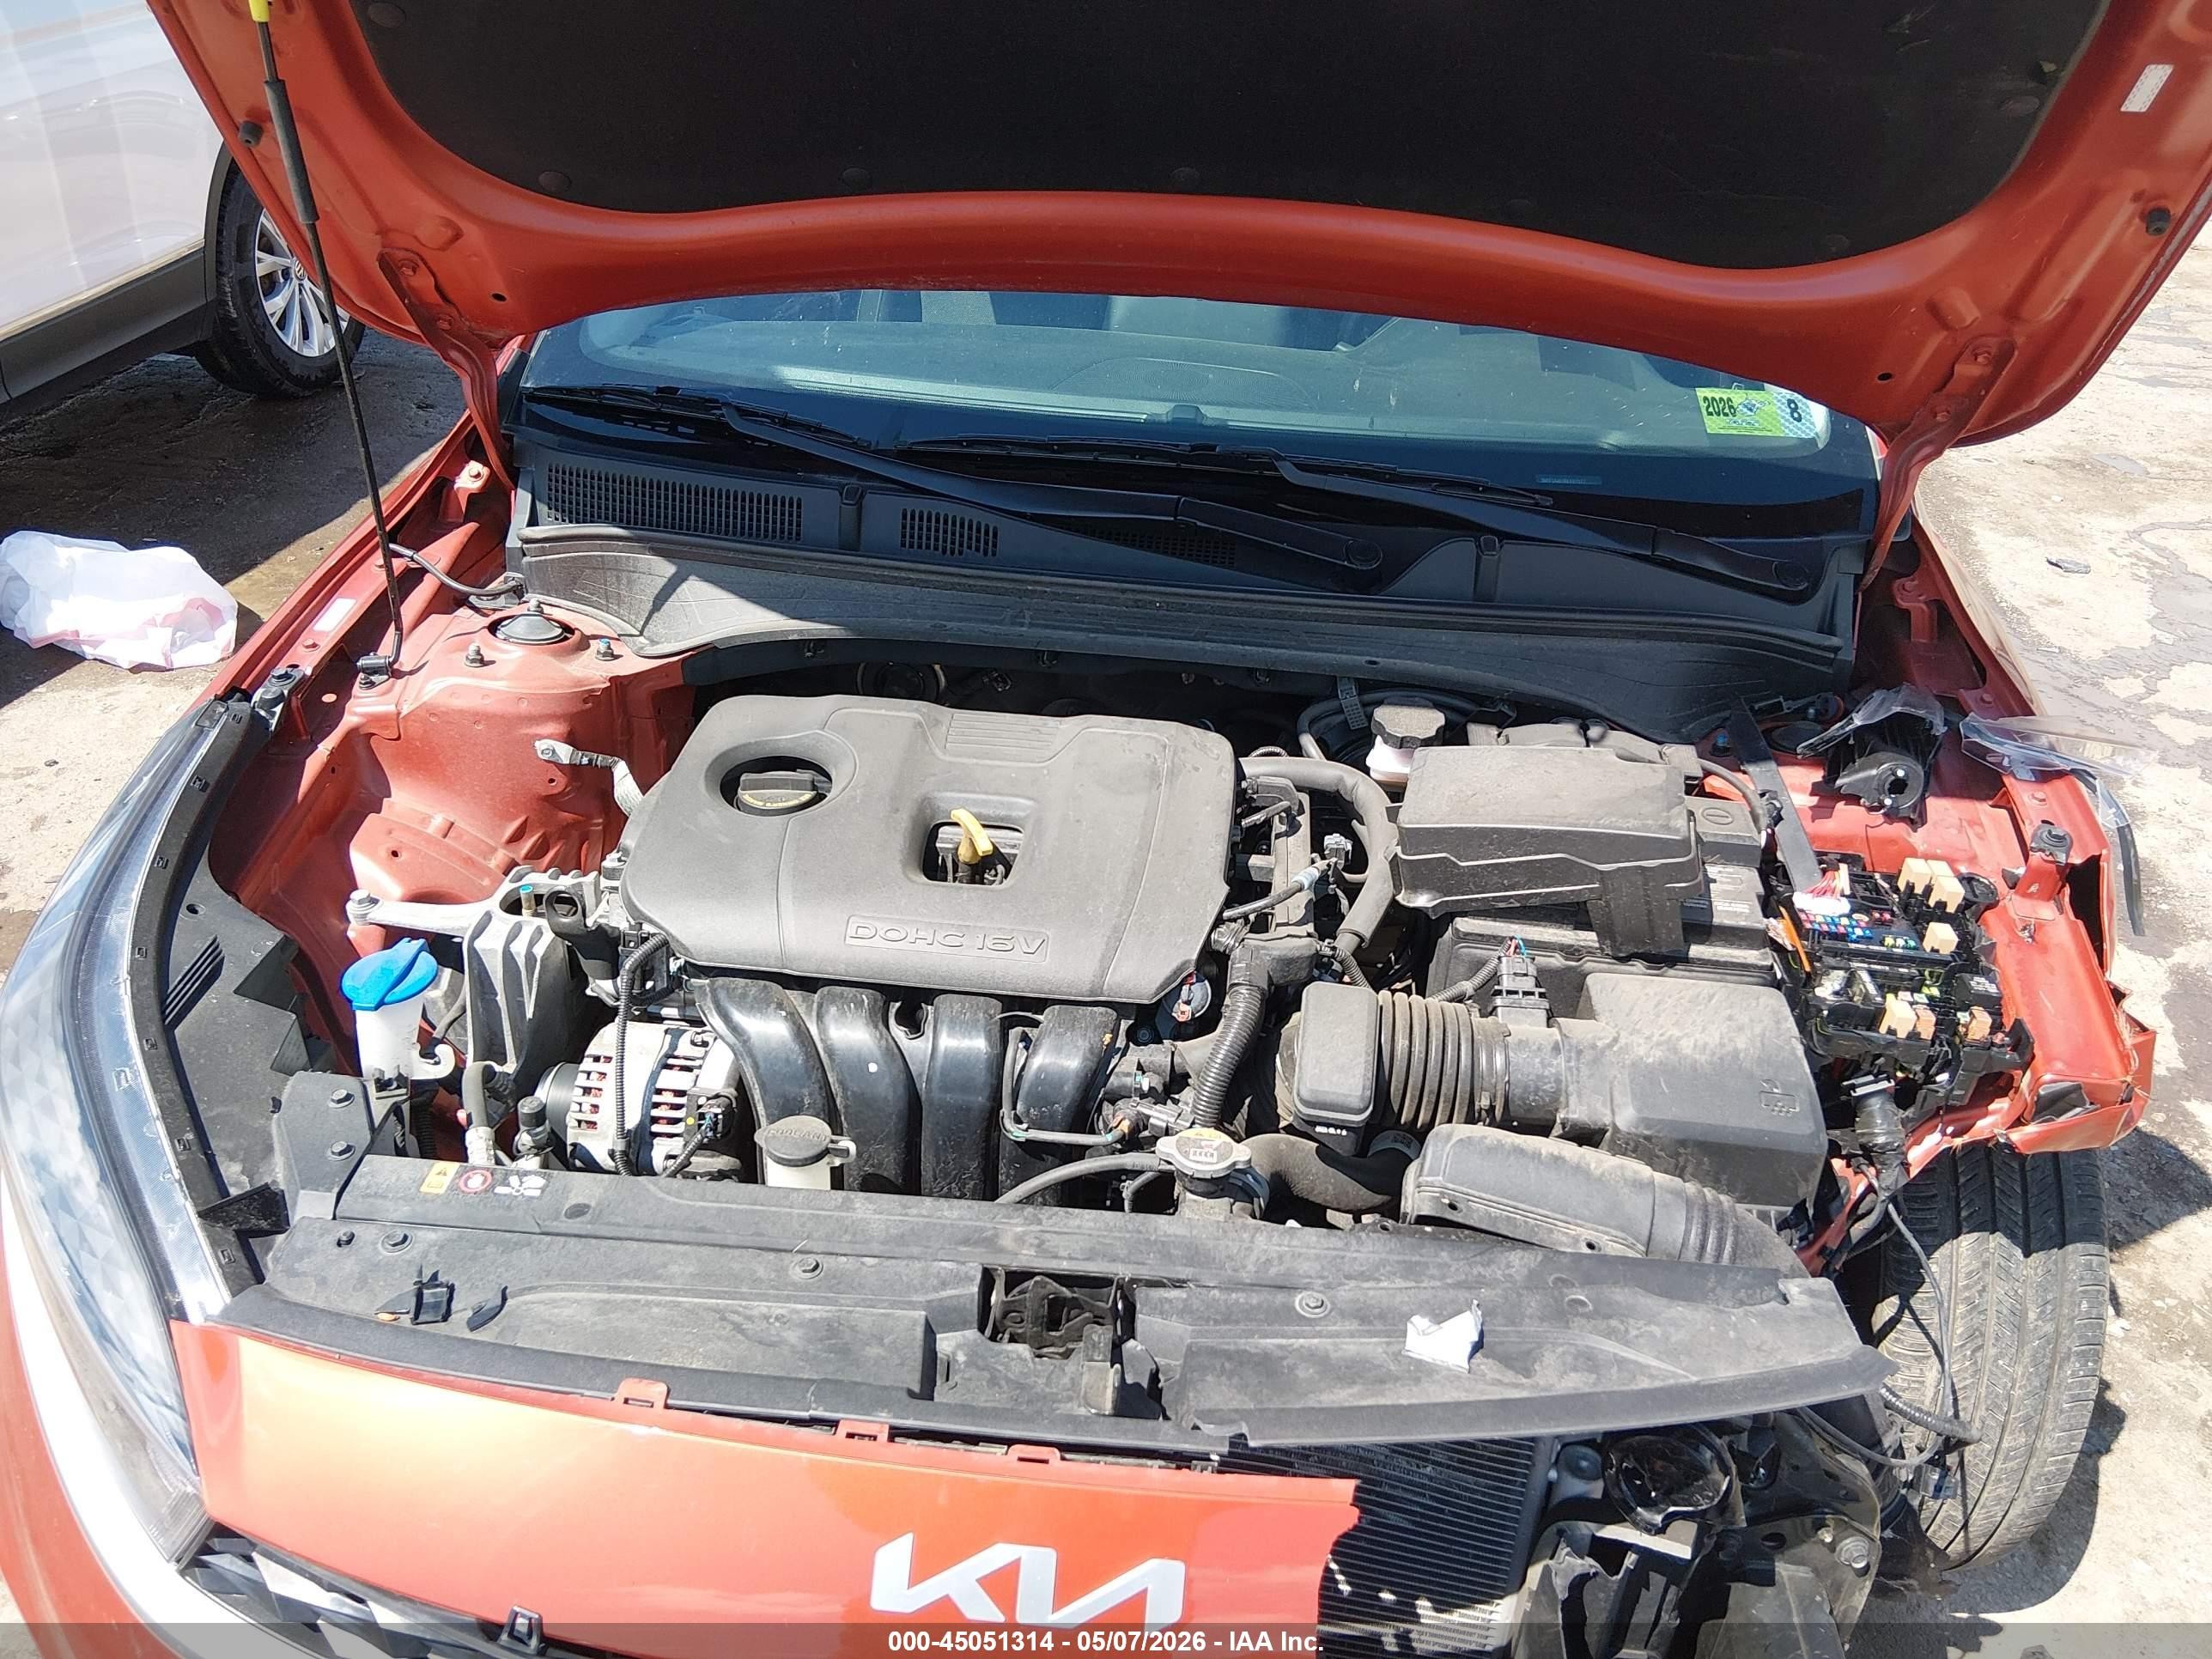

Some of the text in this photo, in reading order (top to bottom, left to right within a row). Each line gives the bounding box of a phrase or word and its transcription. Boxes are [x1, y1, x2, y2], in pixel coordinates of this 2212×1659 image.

[1703, 396, 1737, 417] 2026
[1787, 398, 1802, 422] 8
[849, 922, 1046, 955] DOHC 16V
[870, 1531, 1186, 1633] KIA
